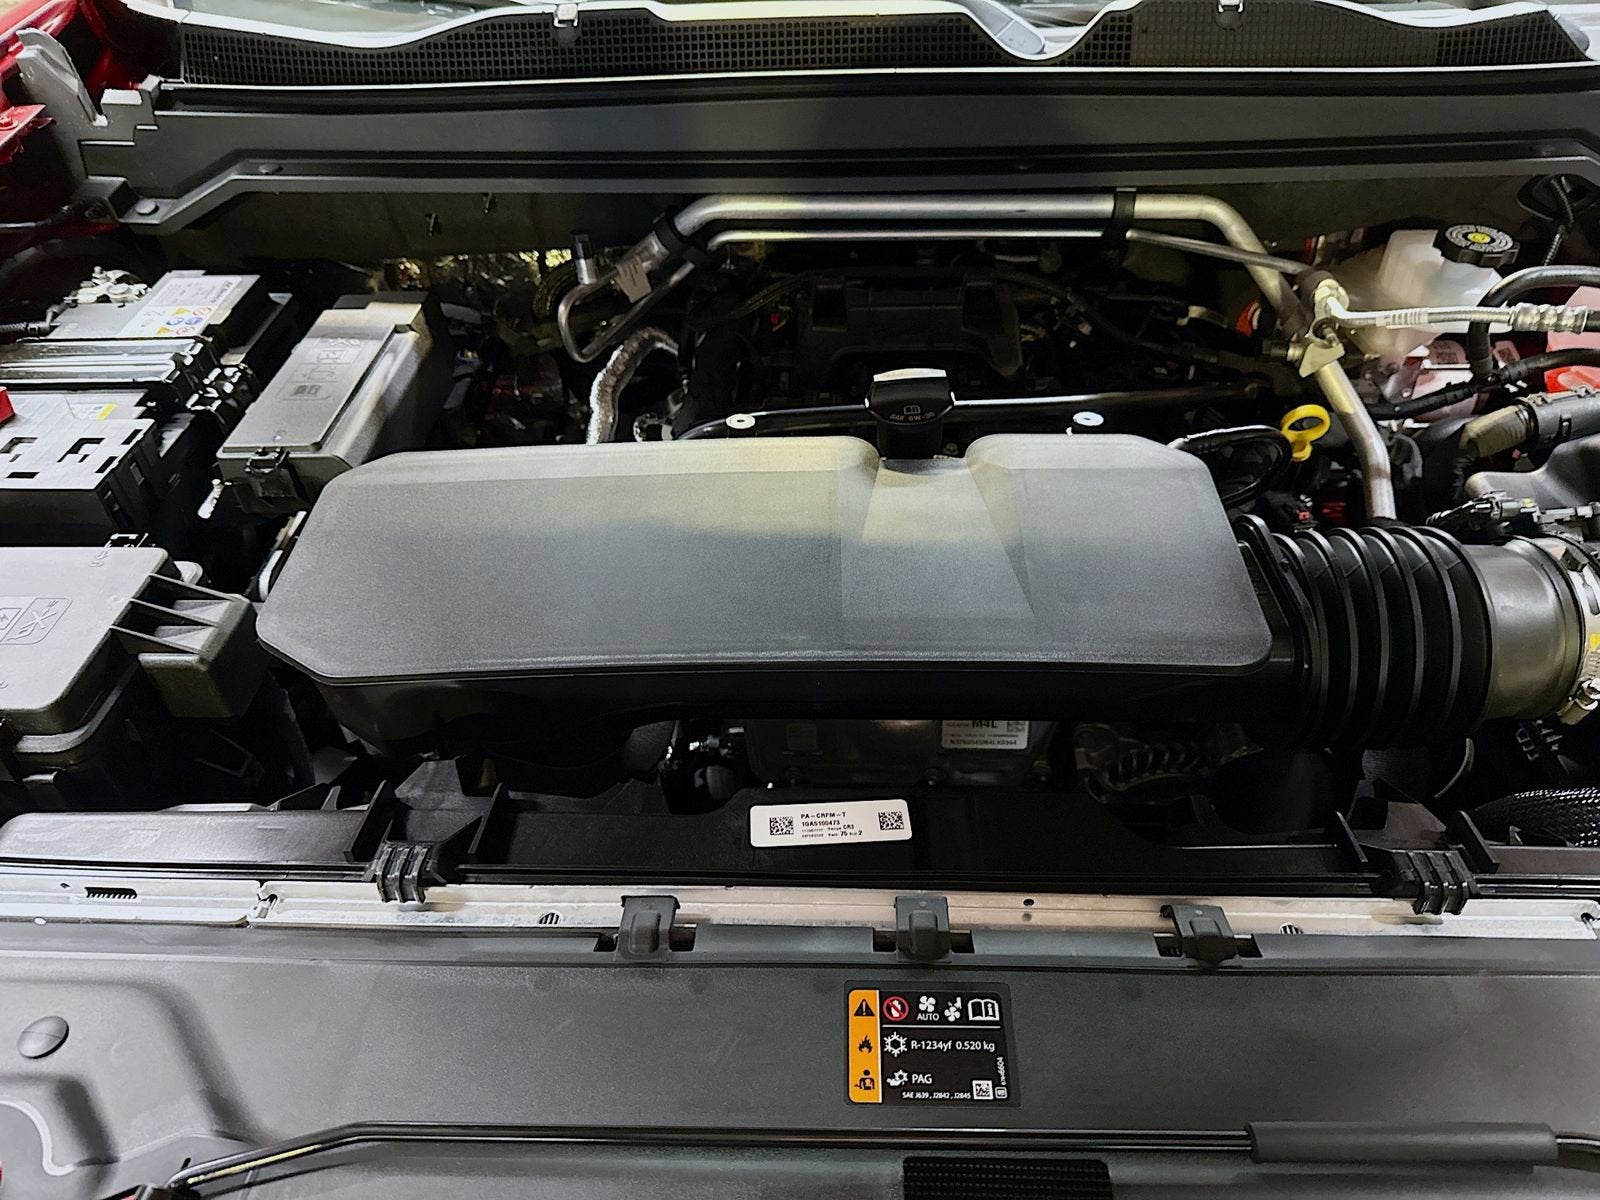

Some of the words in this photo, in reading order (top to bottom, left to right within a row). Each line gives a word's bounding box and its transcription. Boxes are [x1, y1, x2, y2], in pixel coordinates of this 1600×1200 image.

[916, 1013, 940, 1021] AUTO
[911, 1040, 952, 1052] R-1234yf
[955, 1041, 982, 1050] 0.520
[983, 1041, 995, 1052] kg
[912, 1073, 933, 1084] PAG
[902, 1091, 914, 1099] SAE
